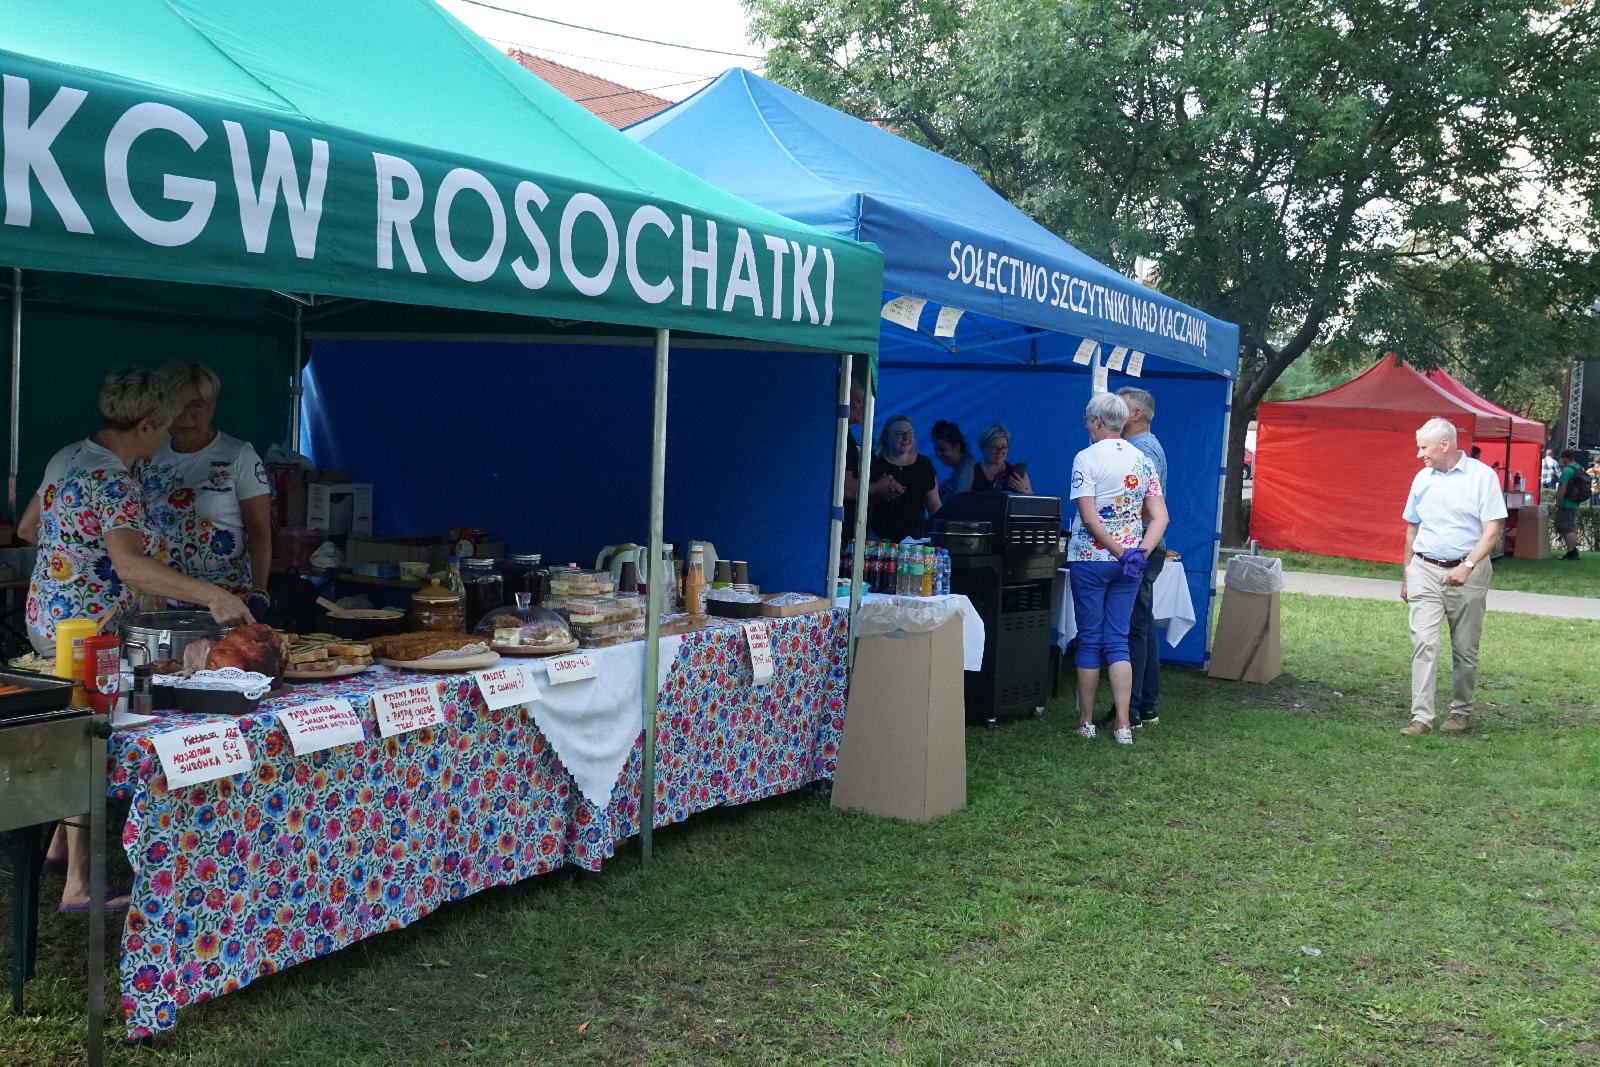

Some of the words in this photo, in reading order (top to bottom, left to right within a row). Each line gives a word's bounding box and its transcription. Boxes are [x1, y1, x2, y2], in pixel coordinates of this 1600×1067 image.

[3, 73, 330, 260] KGW
[372, 151, 835, 327] ROSOCHATKI
[947, 240, 1048, 303] SOŁECTWO
[1050, 271, 1130, 326] SZCZYTNIKI
[1132, 296, 1158, 333] NAD
[1159, 305, 1208, 357] KACZAWĄ
[409, 687, 428, 697] BIGOS
[180, 756, 221, 773] SURÓWKA
